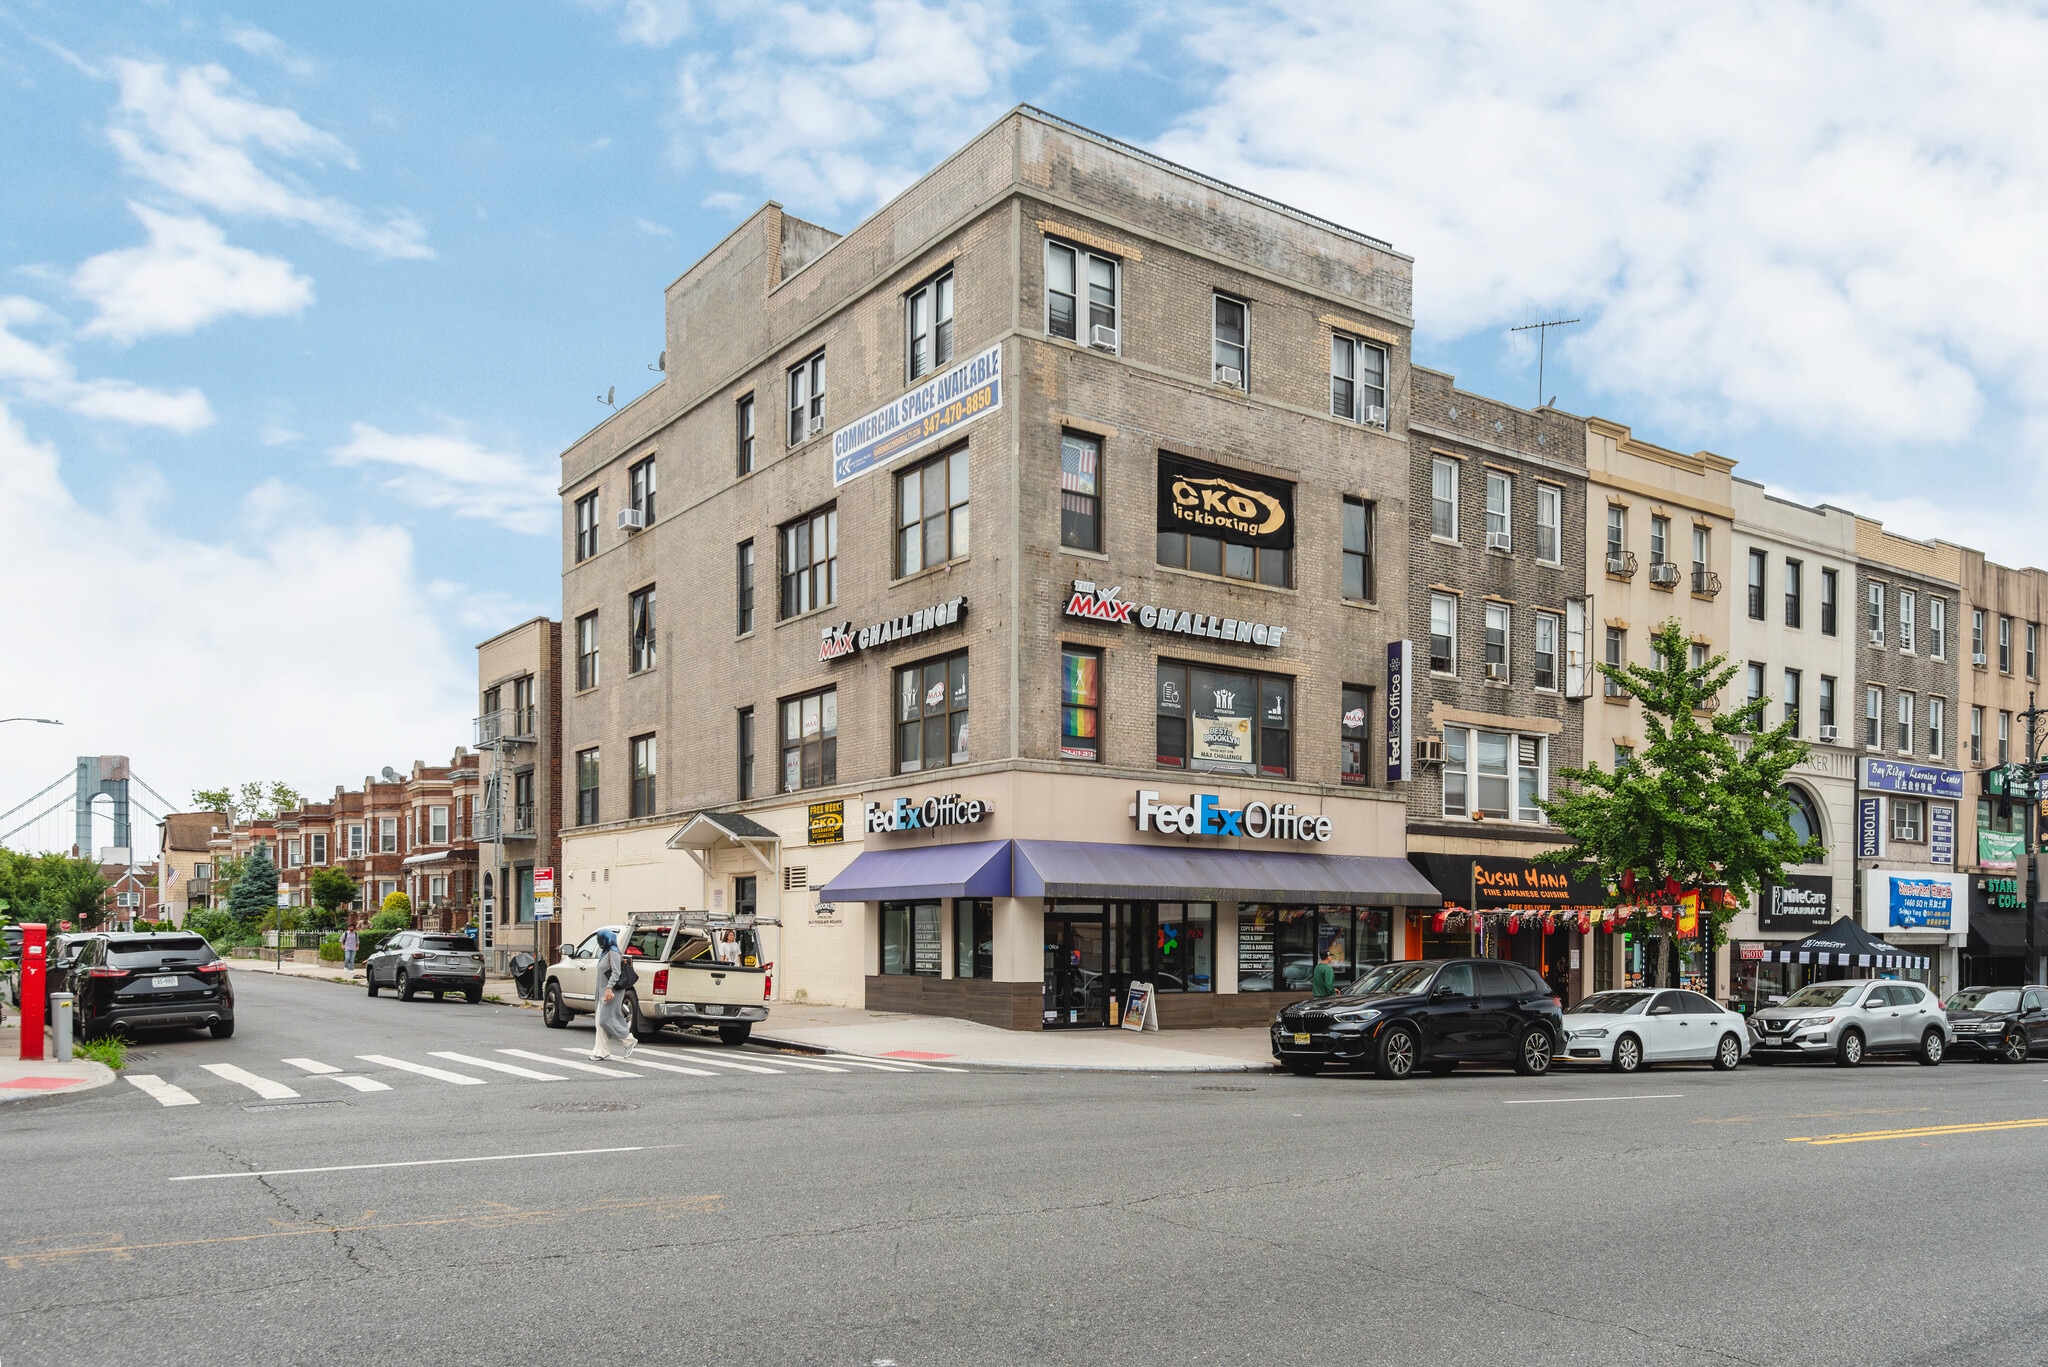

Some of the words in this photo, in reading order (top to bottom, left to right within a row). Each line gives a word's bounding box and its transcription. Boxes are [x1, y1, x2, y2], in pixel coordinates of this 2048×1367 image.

[836, 404, 900, 457] COMMERCIAL
[901, 384, 935, 422] SPACE
[937, 349, 999, 405] AVAILABLE
[923, 386, 992, 437] 347-470-8850
[1075, 581, 1095, 593] THE
[1066, 593, 1136, 624] MAX
[1140, 606, 1284, 647] CHALLENGE
[818, 631, 856, 662] MAX
[858, 600, 960, 650] CHALLENGE
[928, 691, 943, 699] MAX
[1389, 674, 1400, 719] Office
[1344, 714, 1363, 723] MAX
[1209, 727, 1229, 735] BEST
[1203, 734, 1240, 745] BROOKLYN
[1389, 719, 1400, 766] FedEx
[1871, 762, 1885, 778] Bay
[1886, 764, 1906, 780] Ridge
[1909, 767, 1937, 785] Learning
[1940, 772, 1961, 785] Center
[810, 805, 824, 814] FREE
[865, 798, 921, 833] FedEx
[922, 793, 981, 828] Office
[1138, 790, 1243, 837] FedEx
[1243, 801, 1333, 842] Office
[811, 817, 836, 828] CKO
[1863, 800, 1876, 856] TUTORING
[1475, 865, 1519, 887] SUSHI
[1524, 868, 1568, 889] HANA
[1483, 888, 1501, 897] FINE
[1502, 890, 1539, 898] JAPANESE
[1540, 891, 1570, 899] CUISINE
[1988, 879, 2017, 893] STARB
[1783, 888, 1826, 904] NileCare
[1998, 894, 2027, 909] COF
[1783, 906, 1826, 915] PHARMACY
[1742, 950, 1763, 959] PHOTO
